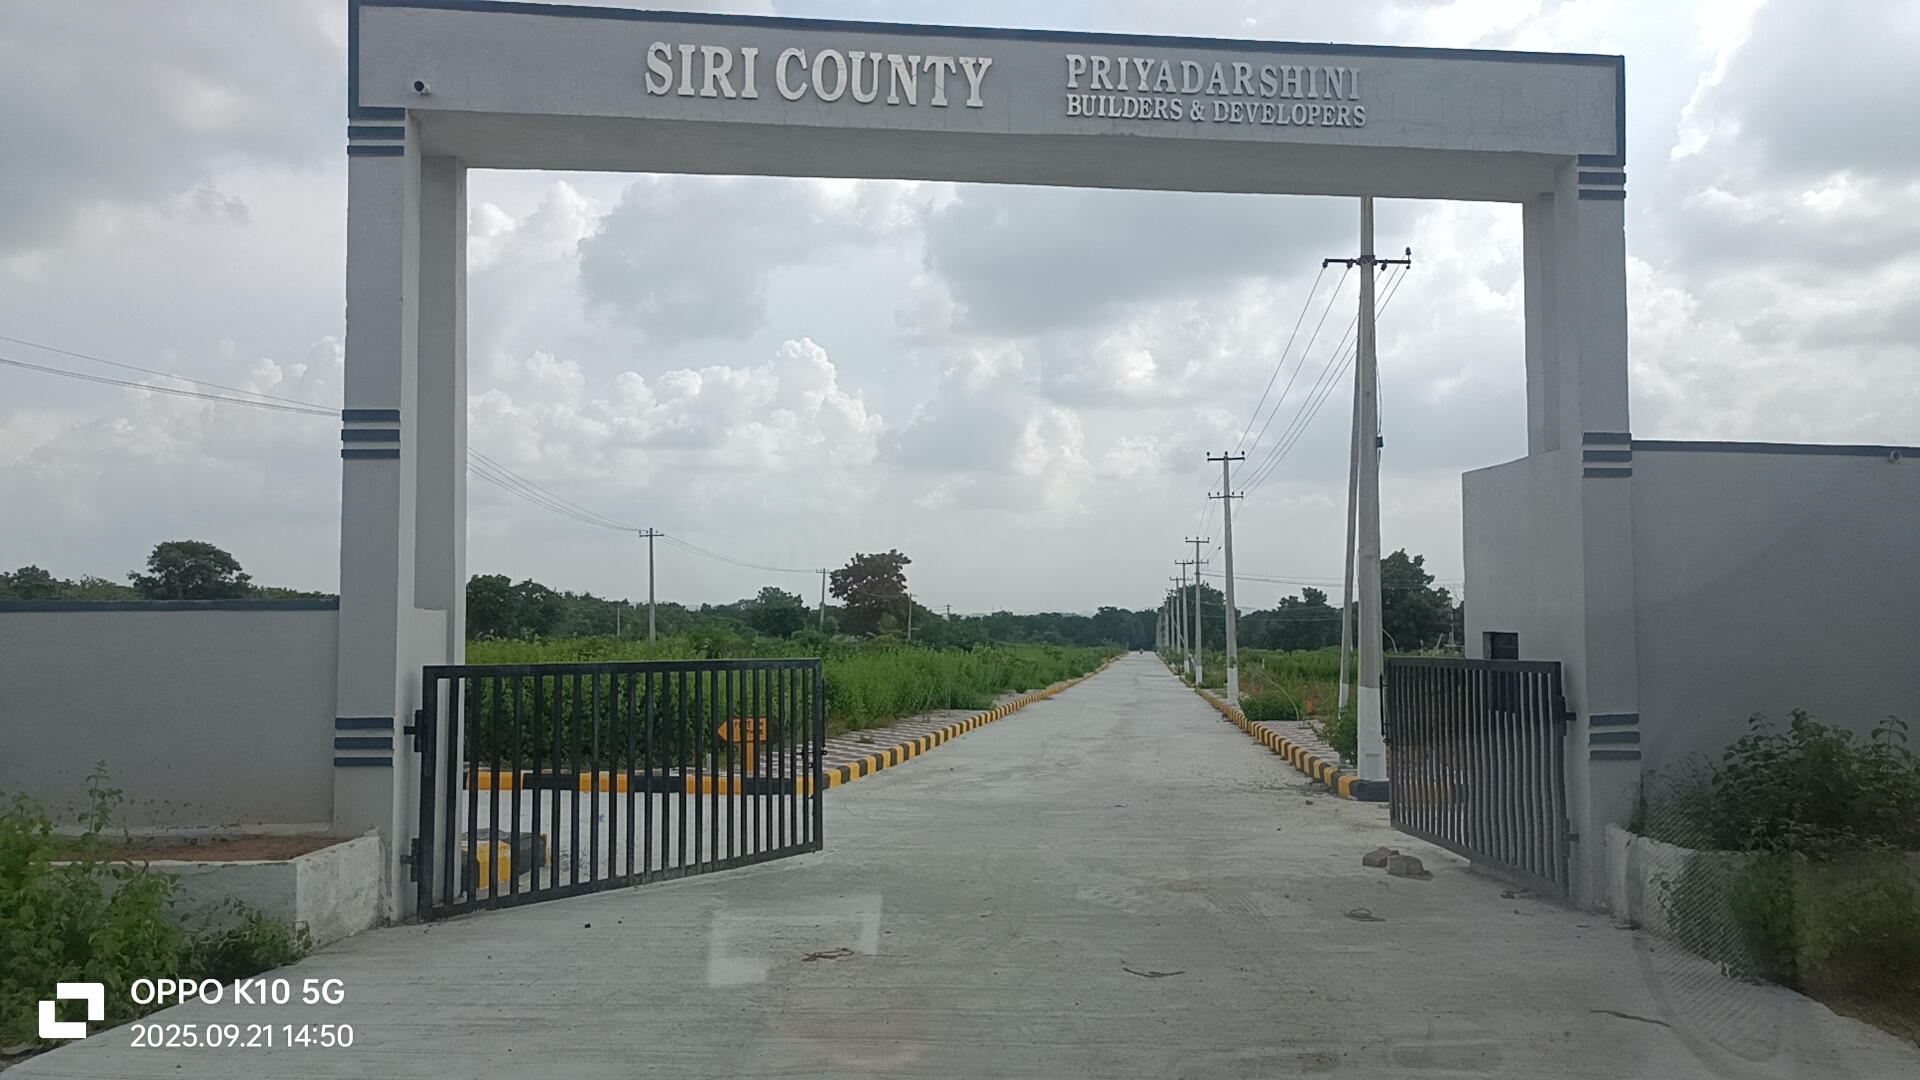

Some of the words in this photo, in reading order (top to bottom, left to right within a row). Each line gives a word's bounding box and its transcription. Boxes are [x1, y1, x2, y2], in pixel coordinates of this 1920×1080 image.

[644, 41, 759, 99] SIRI
[775, 47, 993, 108] COUNTY
[1066, 54, 1360, 100] PRIYADARSHINI
[1066, 94, 1183, 120] BUILDERS
[1190, 100, 1205, 122] &
[1213, 100, 1367, 127] DEVELOPERS
